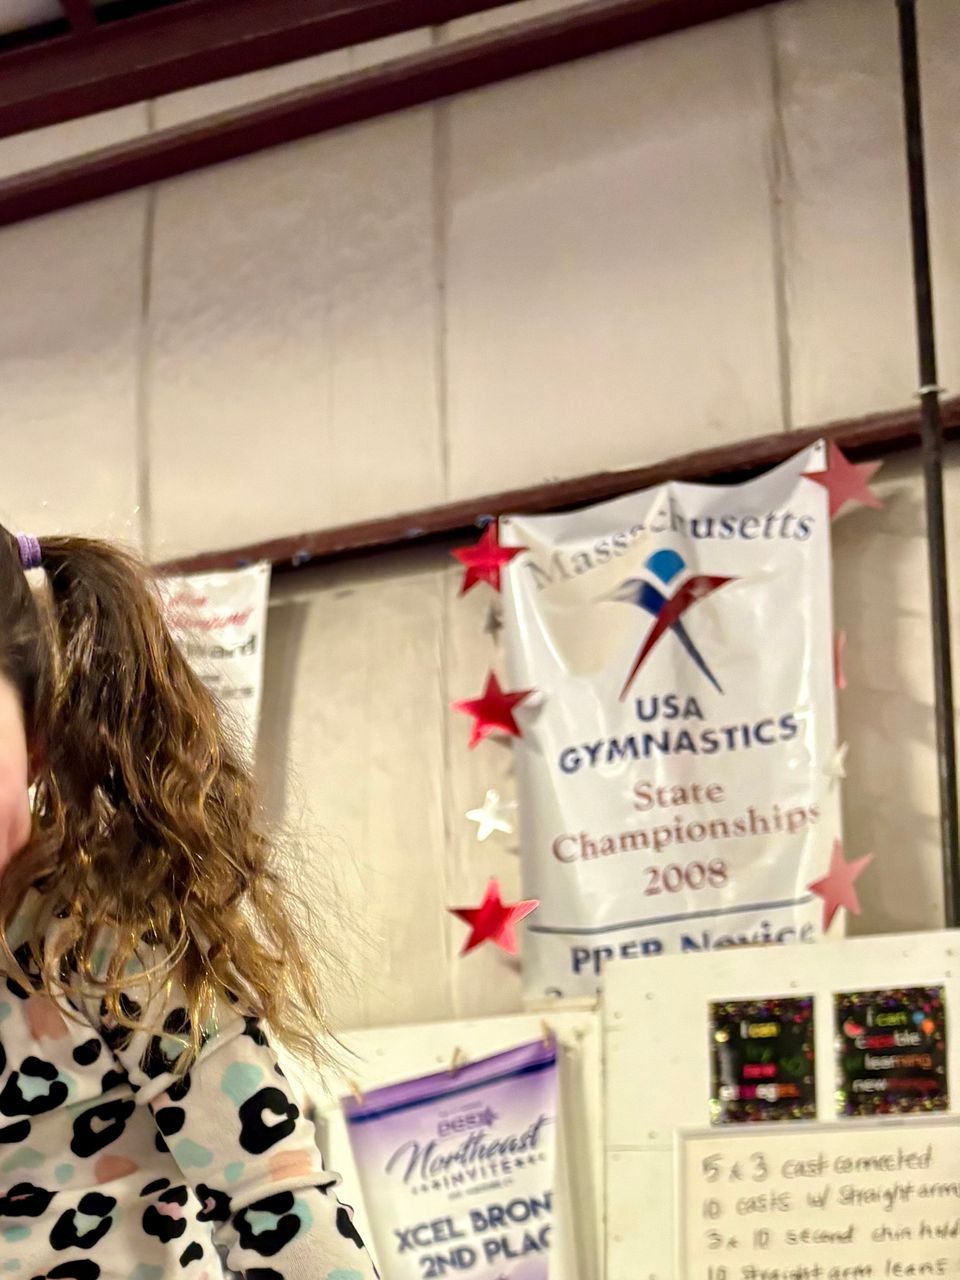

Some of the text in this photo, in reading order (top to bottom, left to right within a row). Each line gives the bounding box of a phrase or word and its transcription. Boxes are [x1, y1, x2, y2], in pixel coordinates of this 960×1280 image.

[526, 508, 816, 591] Massachusetts
[636, 694, 705, 722] USA
[558, 713, 798, 774] GYMNASTICS
[633, 780, 725, 812] State
[552, 802, 821, 864] Championships
[643, 857, 729, 896] 2008
[385, 1113, 556, 1184] Northeast
[749, 1151, 769, 1183] 3
[702, 1198, 723, 1220] 10
[394, 1217, 466, 1254] XCEL
[753, 1227, 771, 1250] 10
[785, 1223, 856, 1246] second
[419, 1246, 478, 1280] 2ND
